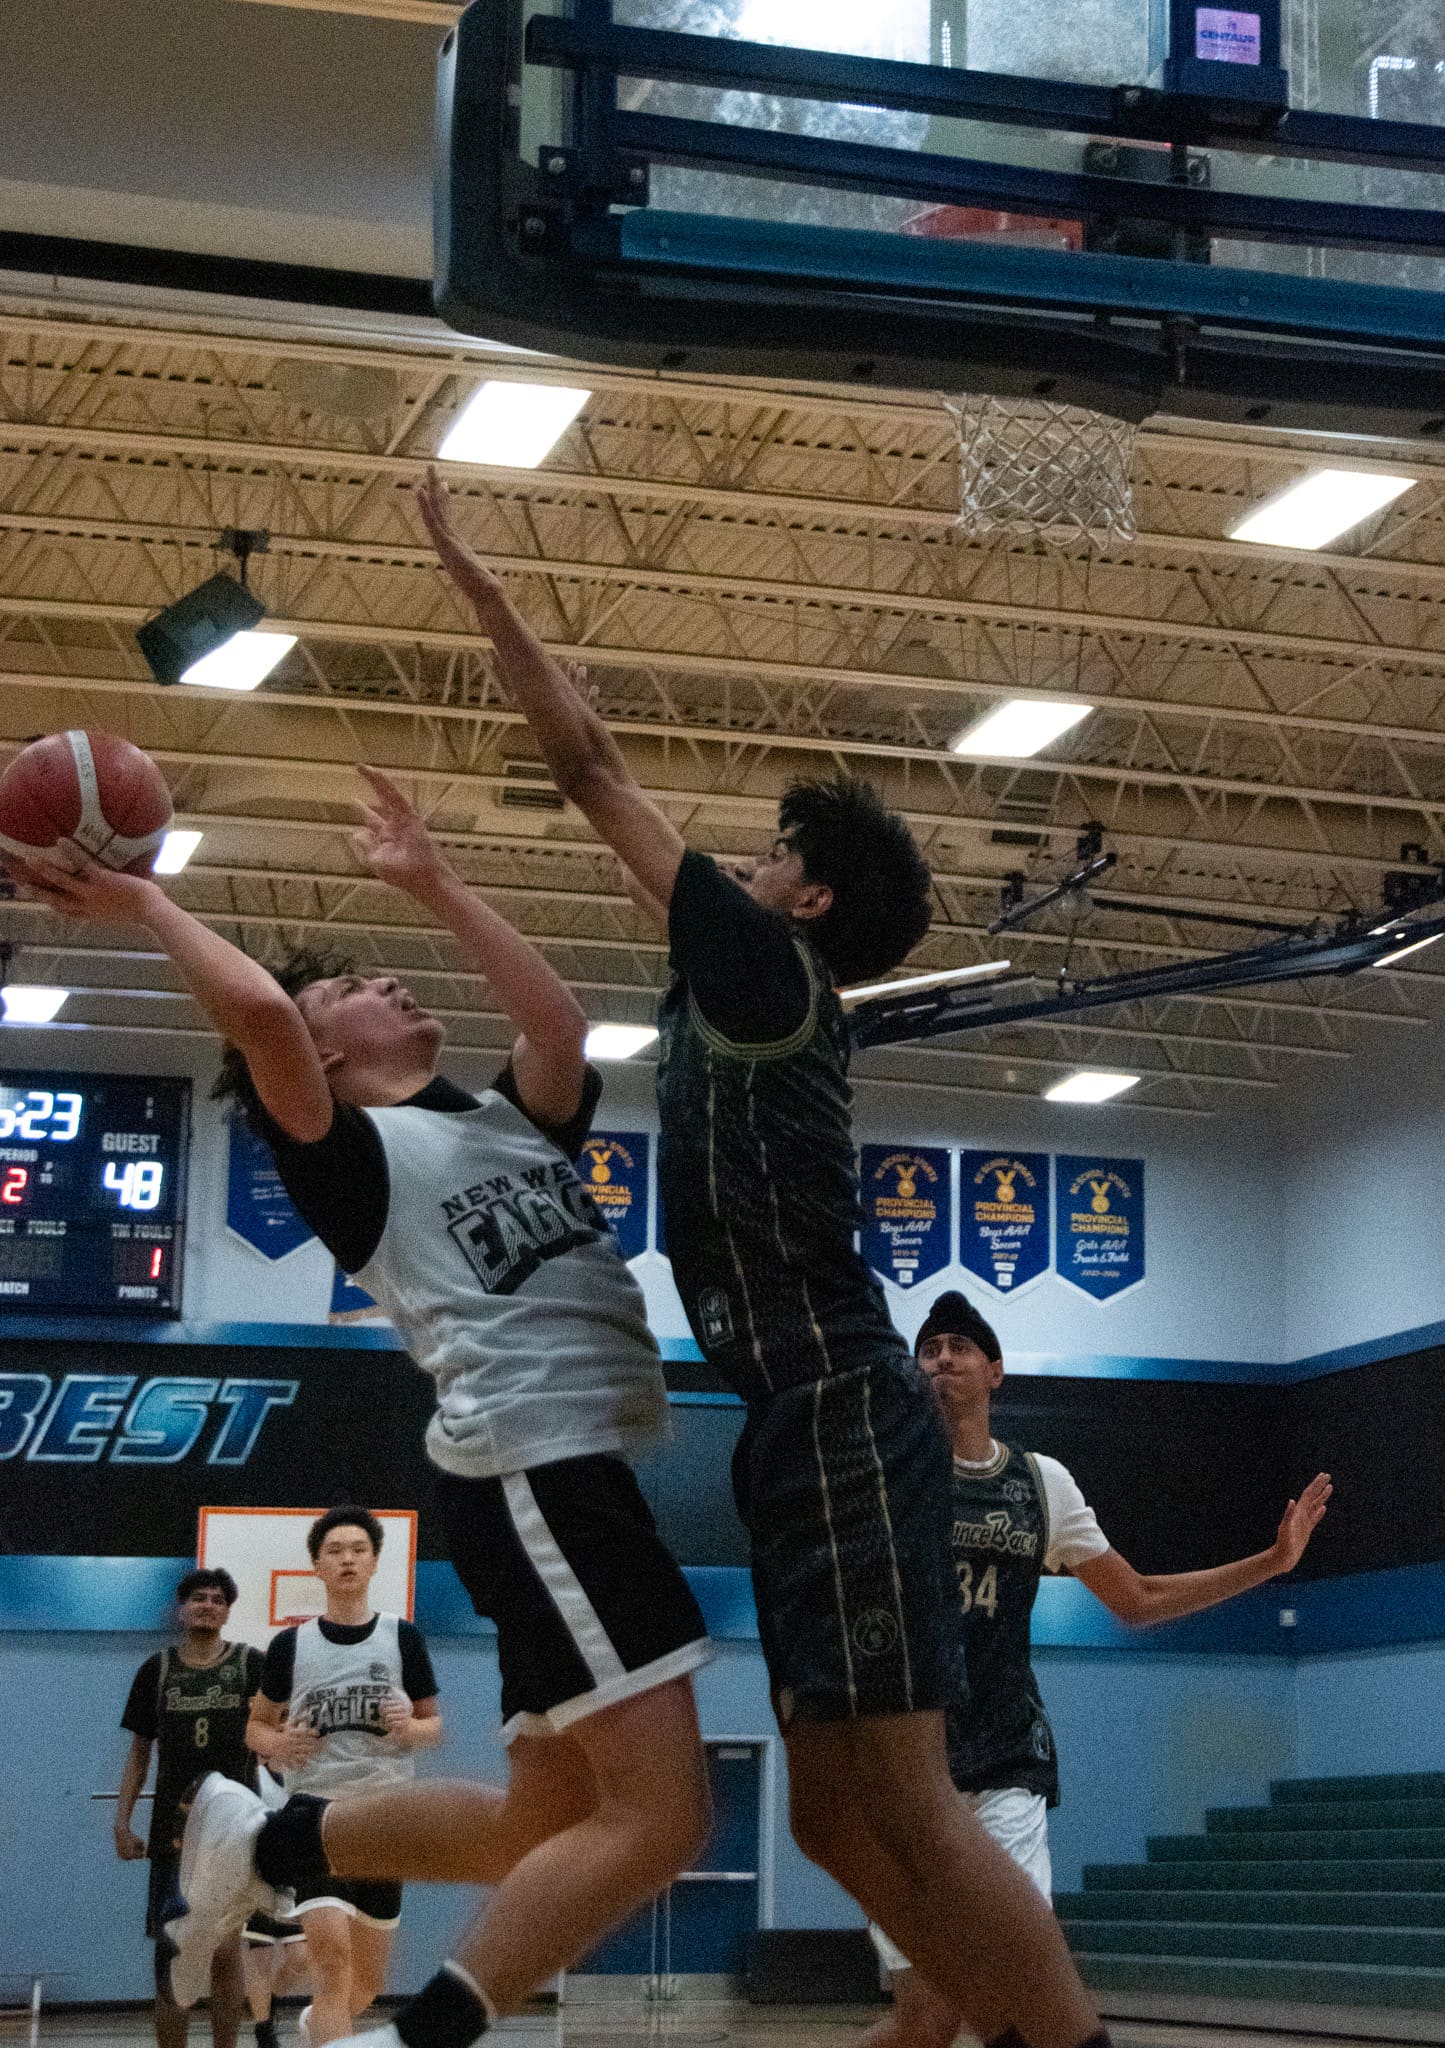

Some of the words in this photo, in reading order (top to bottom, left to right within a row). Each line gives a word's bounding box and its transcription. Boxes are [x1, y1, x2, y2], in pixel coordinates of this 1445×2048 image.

[102, 1132, 160, 1153] GUEST
[3, 1167, 28, 1203] 2
[103, 1160, 164, 1210] 48
[441, 1175, 513, 1220] NEW
[521, 1160, 573, 1189] WE
[876, 1197, 936, 1210] PROVINCIAL
[876, 1206, 937, 1219] CHAMPIONS
[975, 1201, 1035, 1214] PROVINCIAL
[975, 1211, 1036, 1224] CHAMPIONS
[1071, 1212, 1129, 1226] PROVINCIAL
[1071, 1222, 1131, 1236] CHAMPIONS
[150, 1247, 162, 1279] 1
[955, 1560, 999, 1619] 34
[346, 1685, 392, 1697] WEST
[305, 1695, 390, 1739] EAGLE
[194, 1716, 209, 1748] 8
